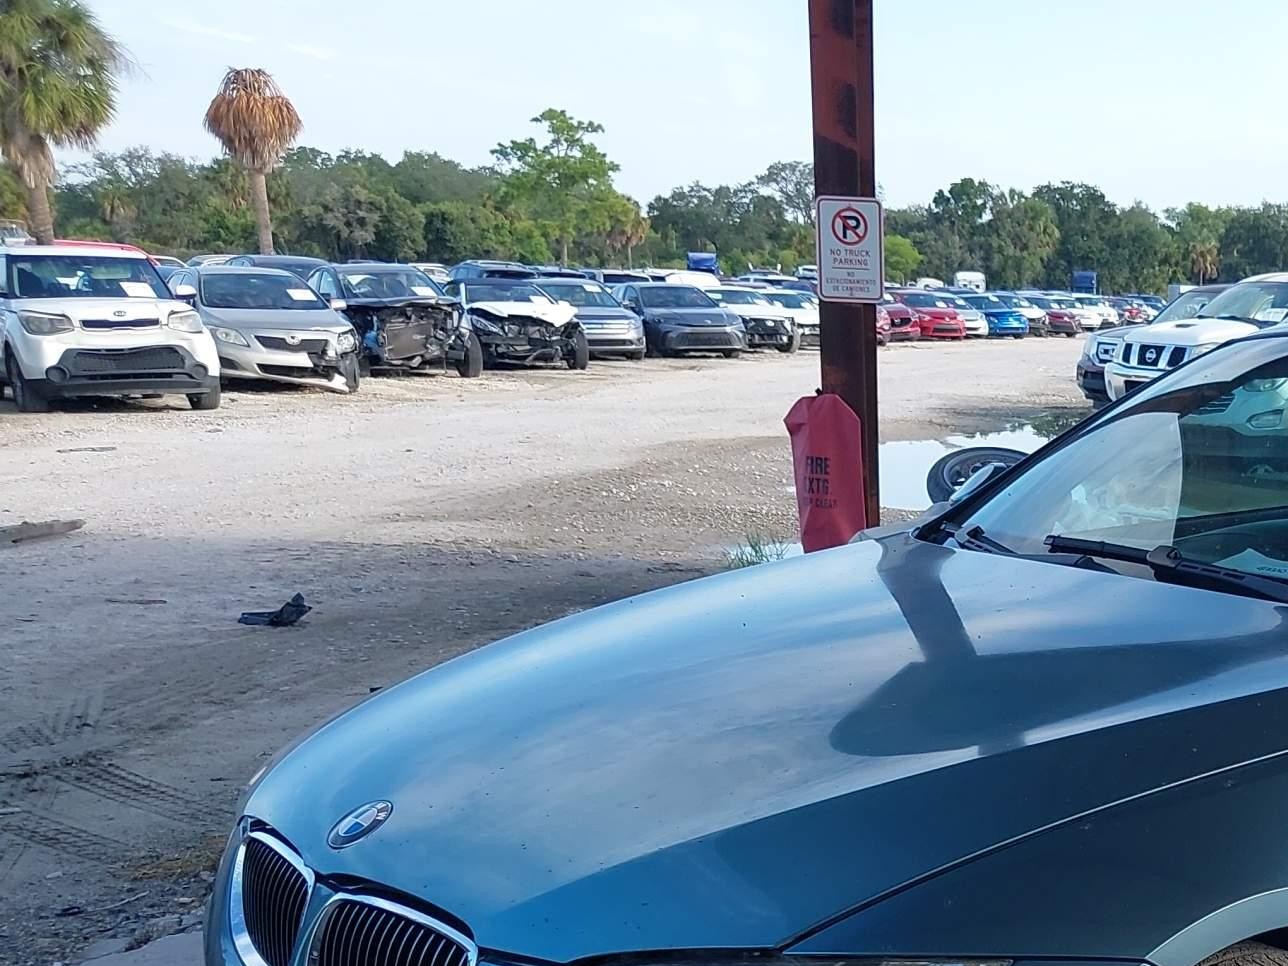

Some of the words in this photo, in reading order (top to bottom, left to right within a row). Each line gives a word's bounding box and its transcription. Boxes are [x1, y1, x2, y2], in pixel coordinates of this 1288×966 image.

[844, 249, 871, 257] TRUCK
[833, 258, 868, 266] PARKING
[806, 456, 830, 475] FIRE
